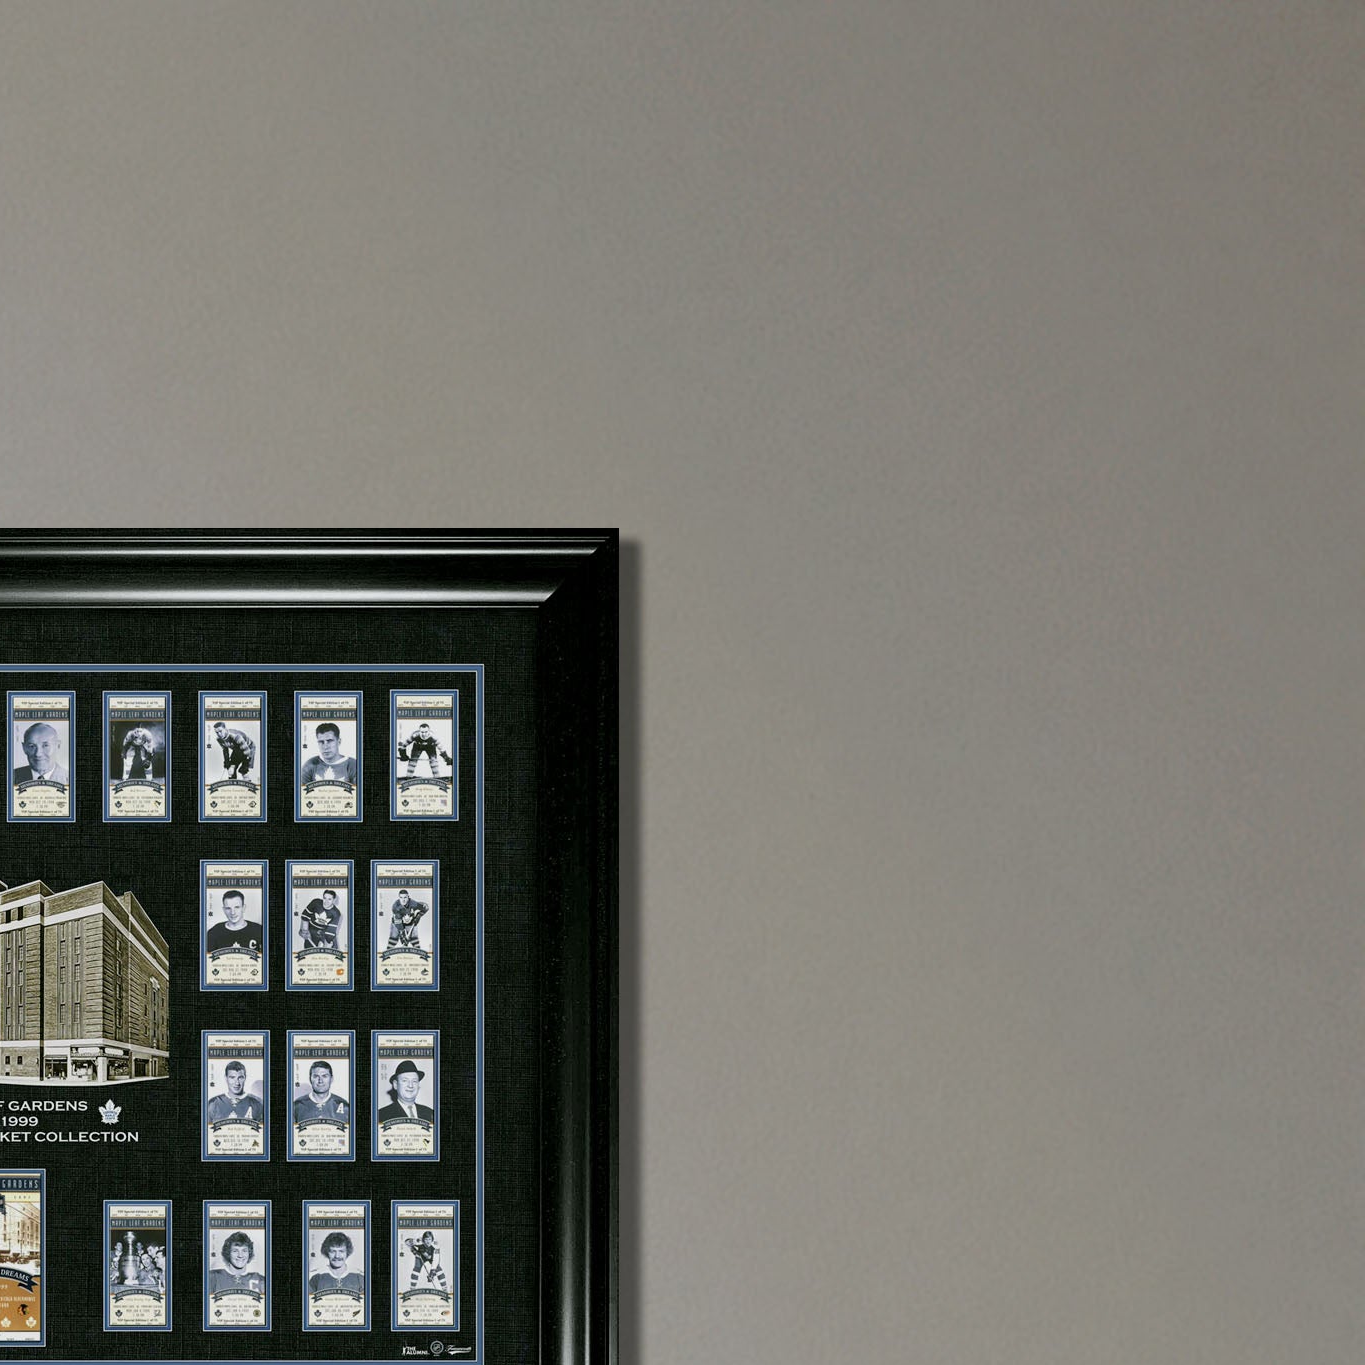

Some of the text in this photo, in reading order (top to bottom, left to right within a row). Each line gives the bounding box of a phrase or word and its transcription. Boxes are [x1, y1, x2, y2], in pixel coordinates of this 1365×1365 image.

[9, 1101, 87, 1111] GARDENS
[336, 1102, 344, 1114] A
[2, 1117, 38, 1126] 1999
[35, 1132, 138, 1142] COLLECTION
[2, 1180, 38, 1188] GARDENS
[1, 1269, 29, 1281] DREAMS
